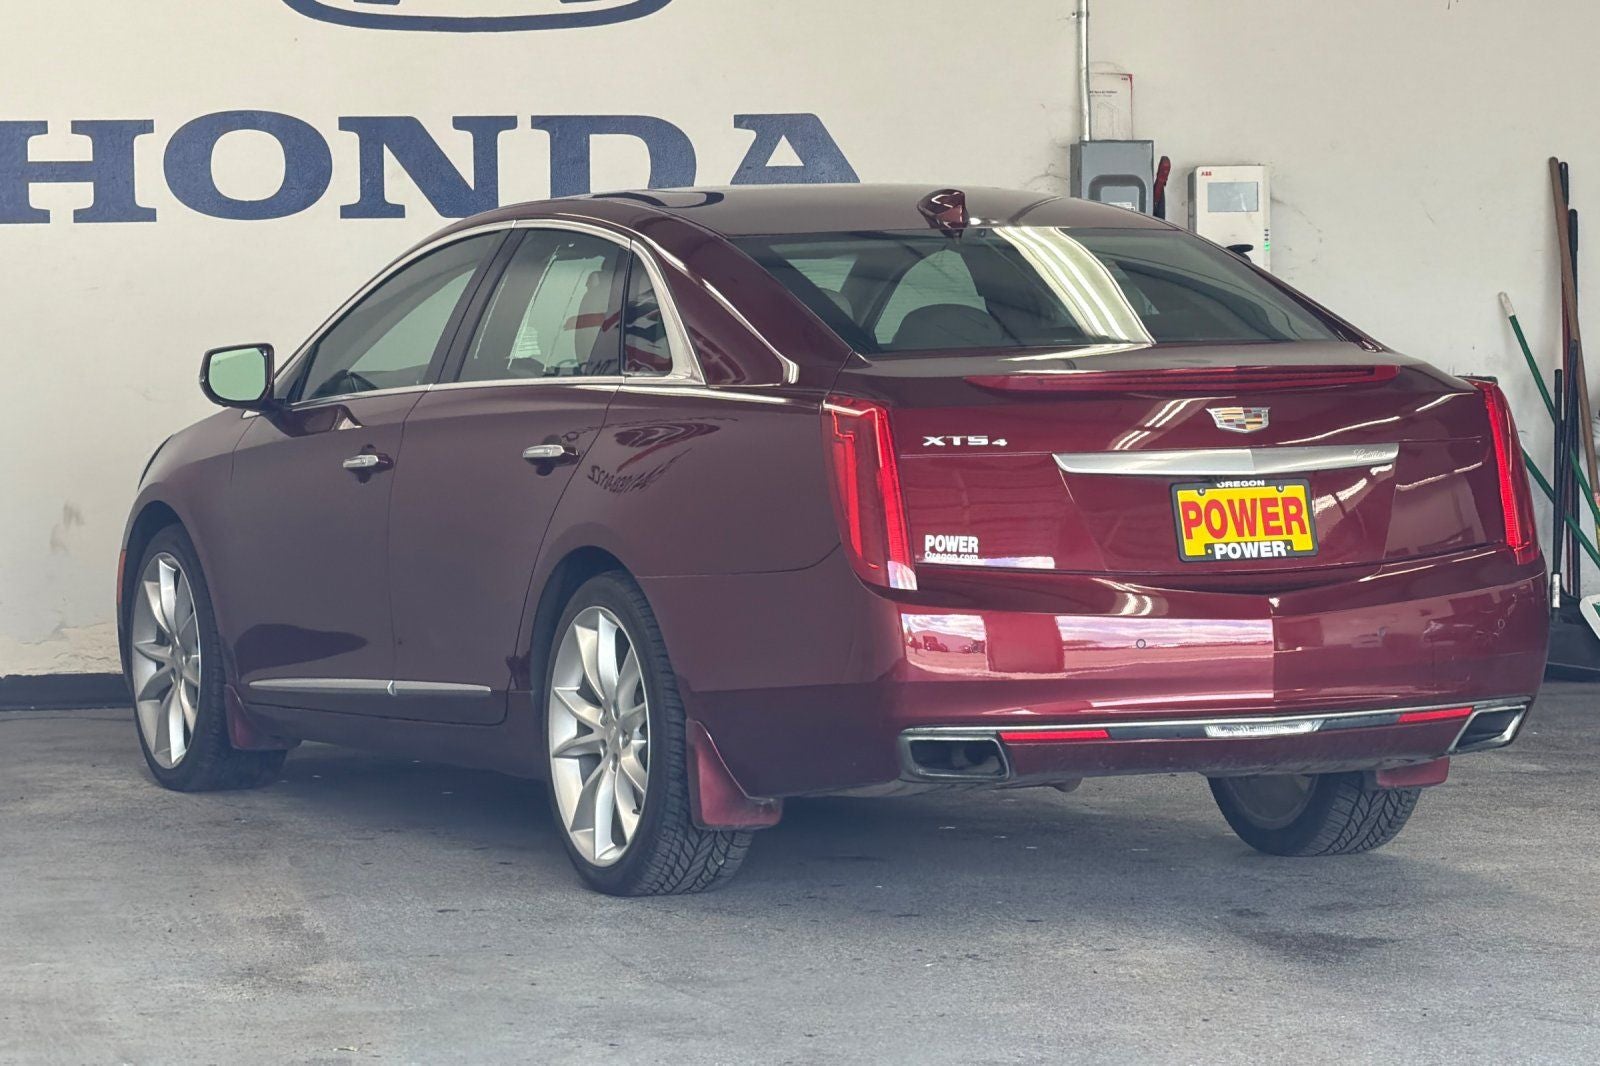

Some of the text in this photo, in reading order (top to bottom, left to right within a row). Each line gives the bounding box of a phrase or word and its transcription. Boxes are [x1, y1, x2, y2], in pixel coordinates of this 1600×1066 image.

[0, 110, 861, 224] HONDA
[1181, 496, 1308, 540] POWER
[925, 534, 979, 553] POWER
[1213, 541, 1287, 560] POWER
